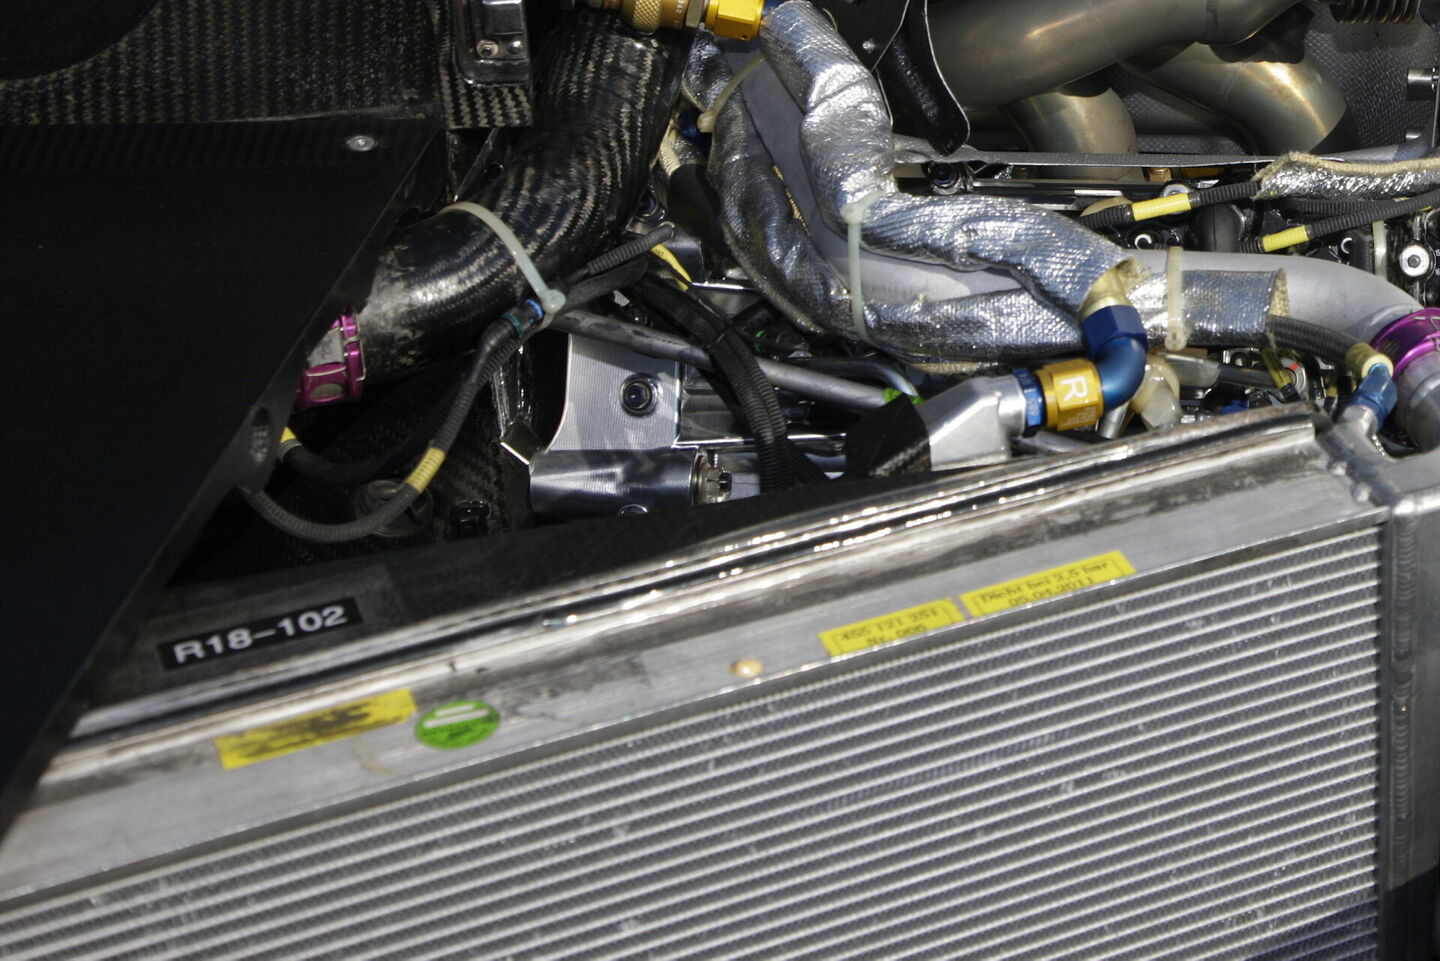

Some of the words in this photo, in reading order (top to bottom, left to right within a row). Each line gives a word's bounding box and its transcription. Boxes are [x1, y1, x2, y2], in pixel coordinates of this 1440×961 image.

[1435, 268, 1440, 276] 16
[1060, 376, 1089, 402] R
[172, 605, 348, 664] R18-102
